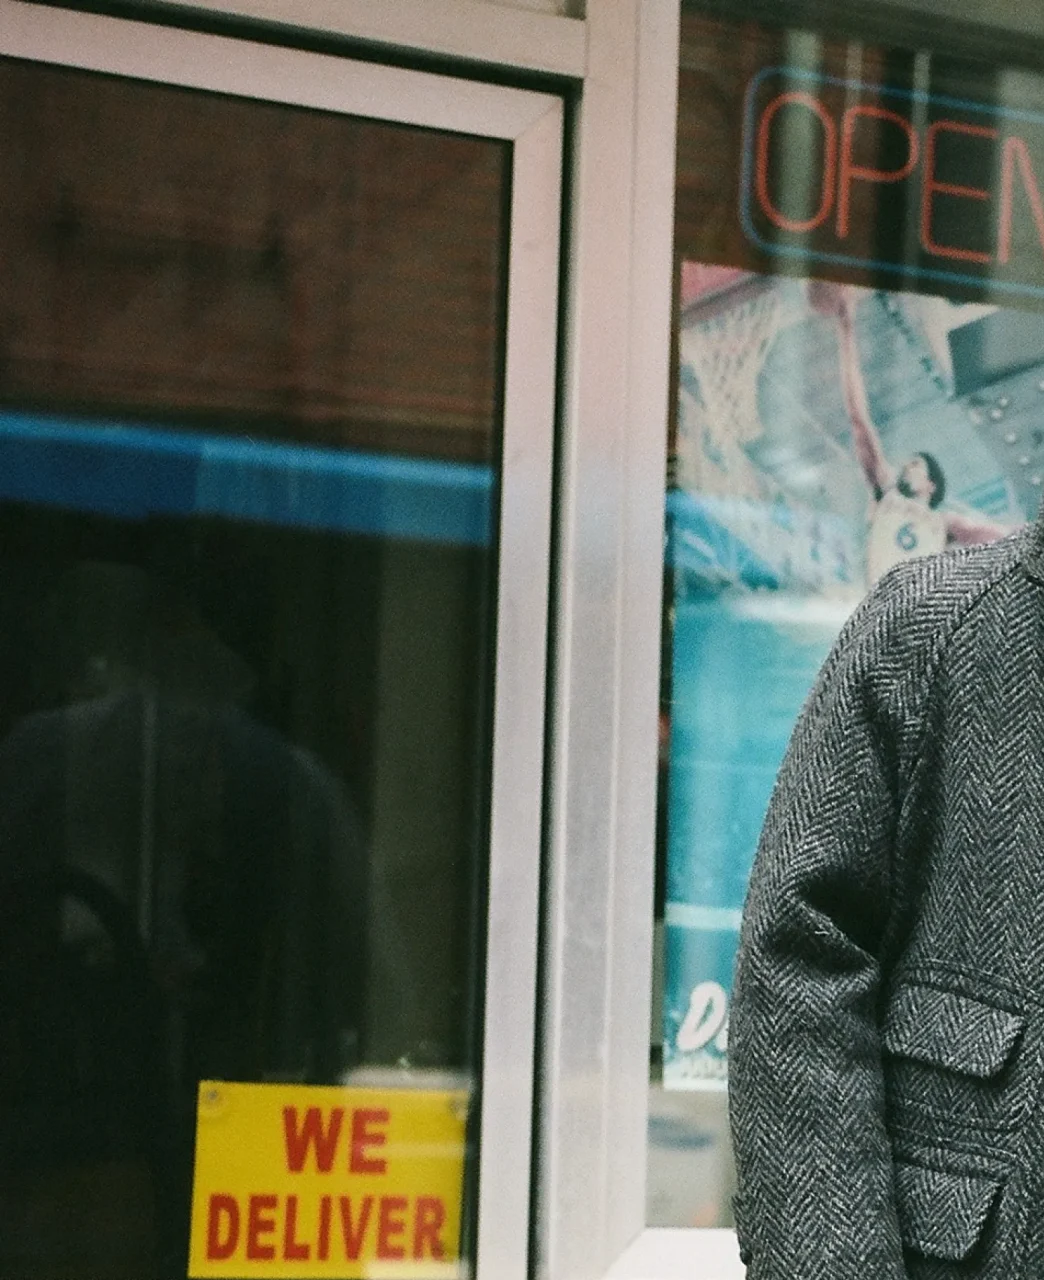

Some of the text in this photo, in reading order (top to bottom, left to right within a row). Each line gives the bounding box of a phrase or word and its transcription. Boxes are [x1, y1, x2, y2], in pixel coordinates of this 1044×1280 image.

[896, 522, 917, 551] 6
[282, 1105, 390, 1174] WE
[206, 1193, 446, 1262] DELIVER
